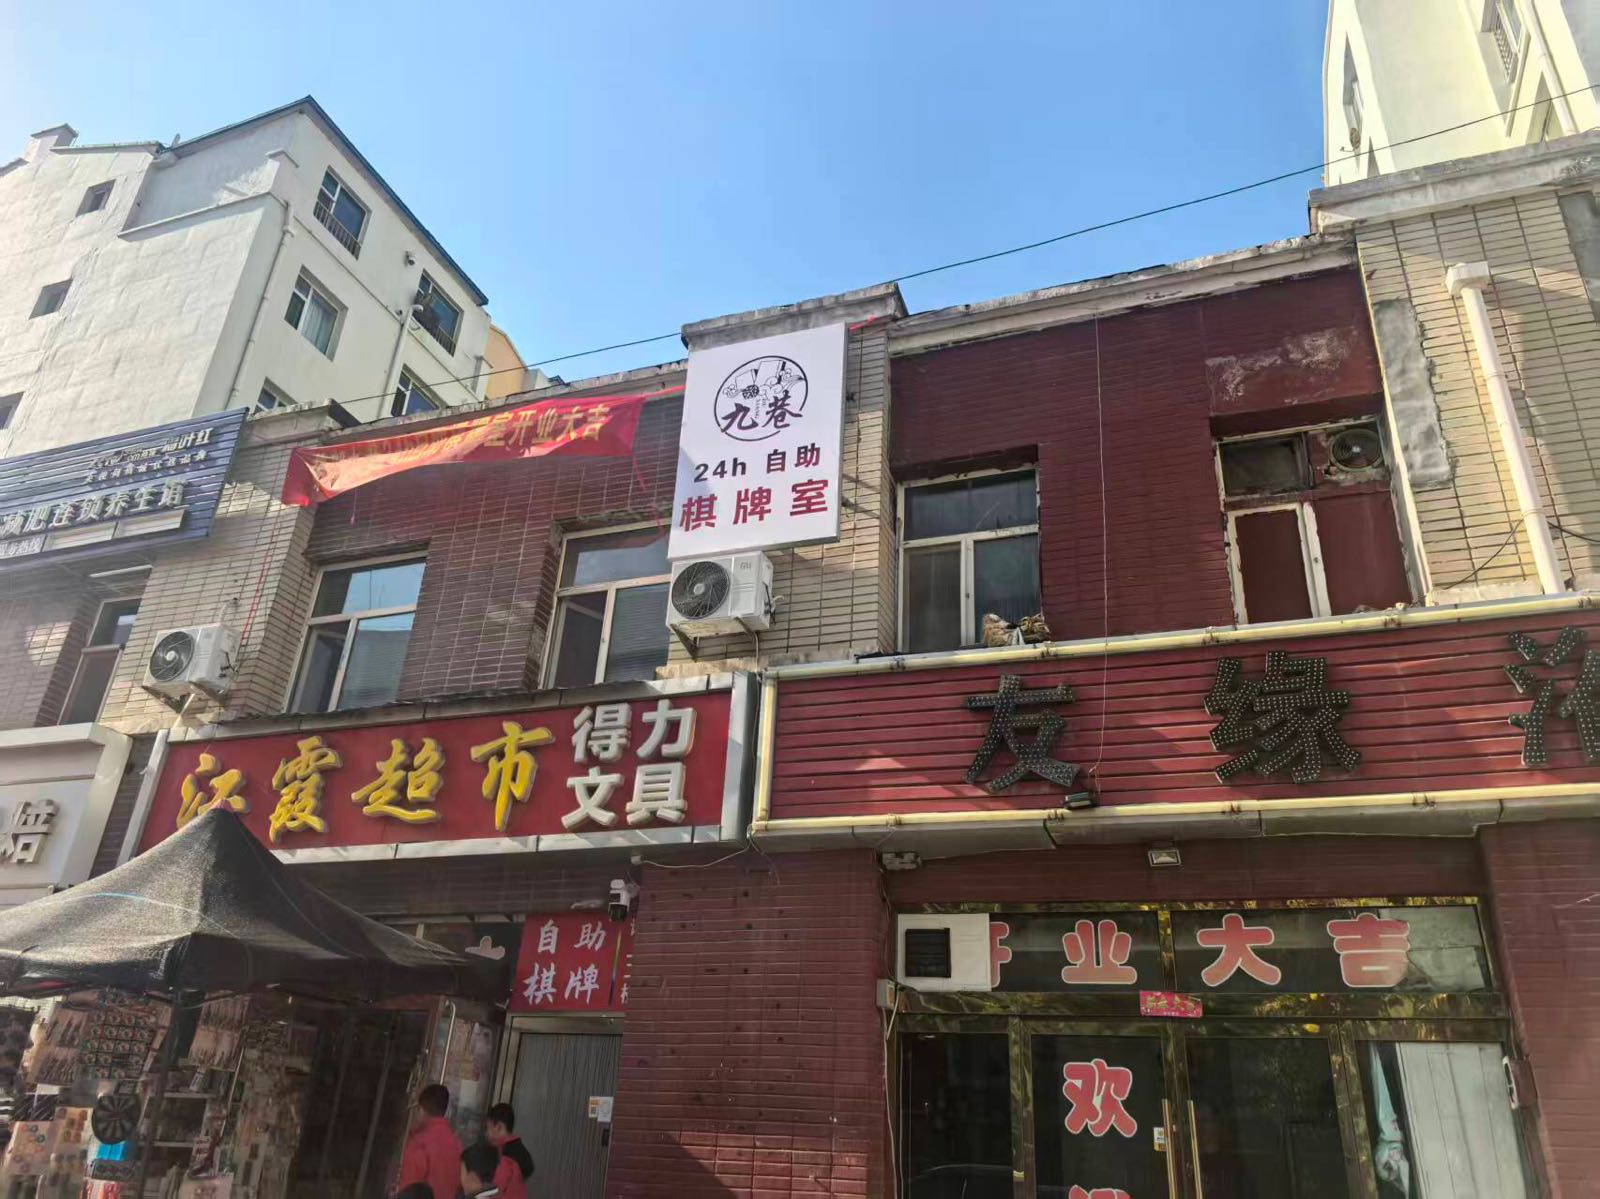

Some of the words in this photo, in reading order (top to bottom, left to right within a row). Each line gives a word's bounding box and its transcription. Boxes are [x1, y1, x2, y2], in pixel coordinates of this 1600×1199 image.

[721, 389, 802, 433] 九巷
[694, 457, 748, 482] 24h
[766, 443, 820, 474] 自助
[679, 479, 828, 532] 棋牌室
[572, 699, 697, 763] 得力
[176, 720, 555, 843] 江霞超市
[561, 762, 687, 830] 文具
[537, 919, 607, 954] 自助
[523, 962, 600, 1006] 棋牌
